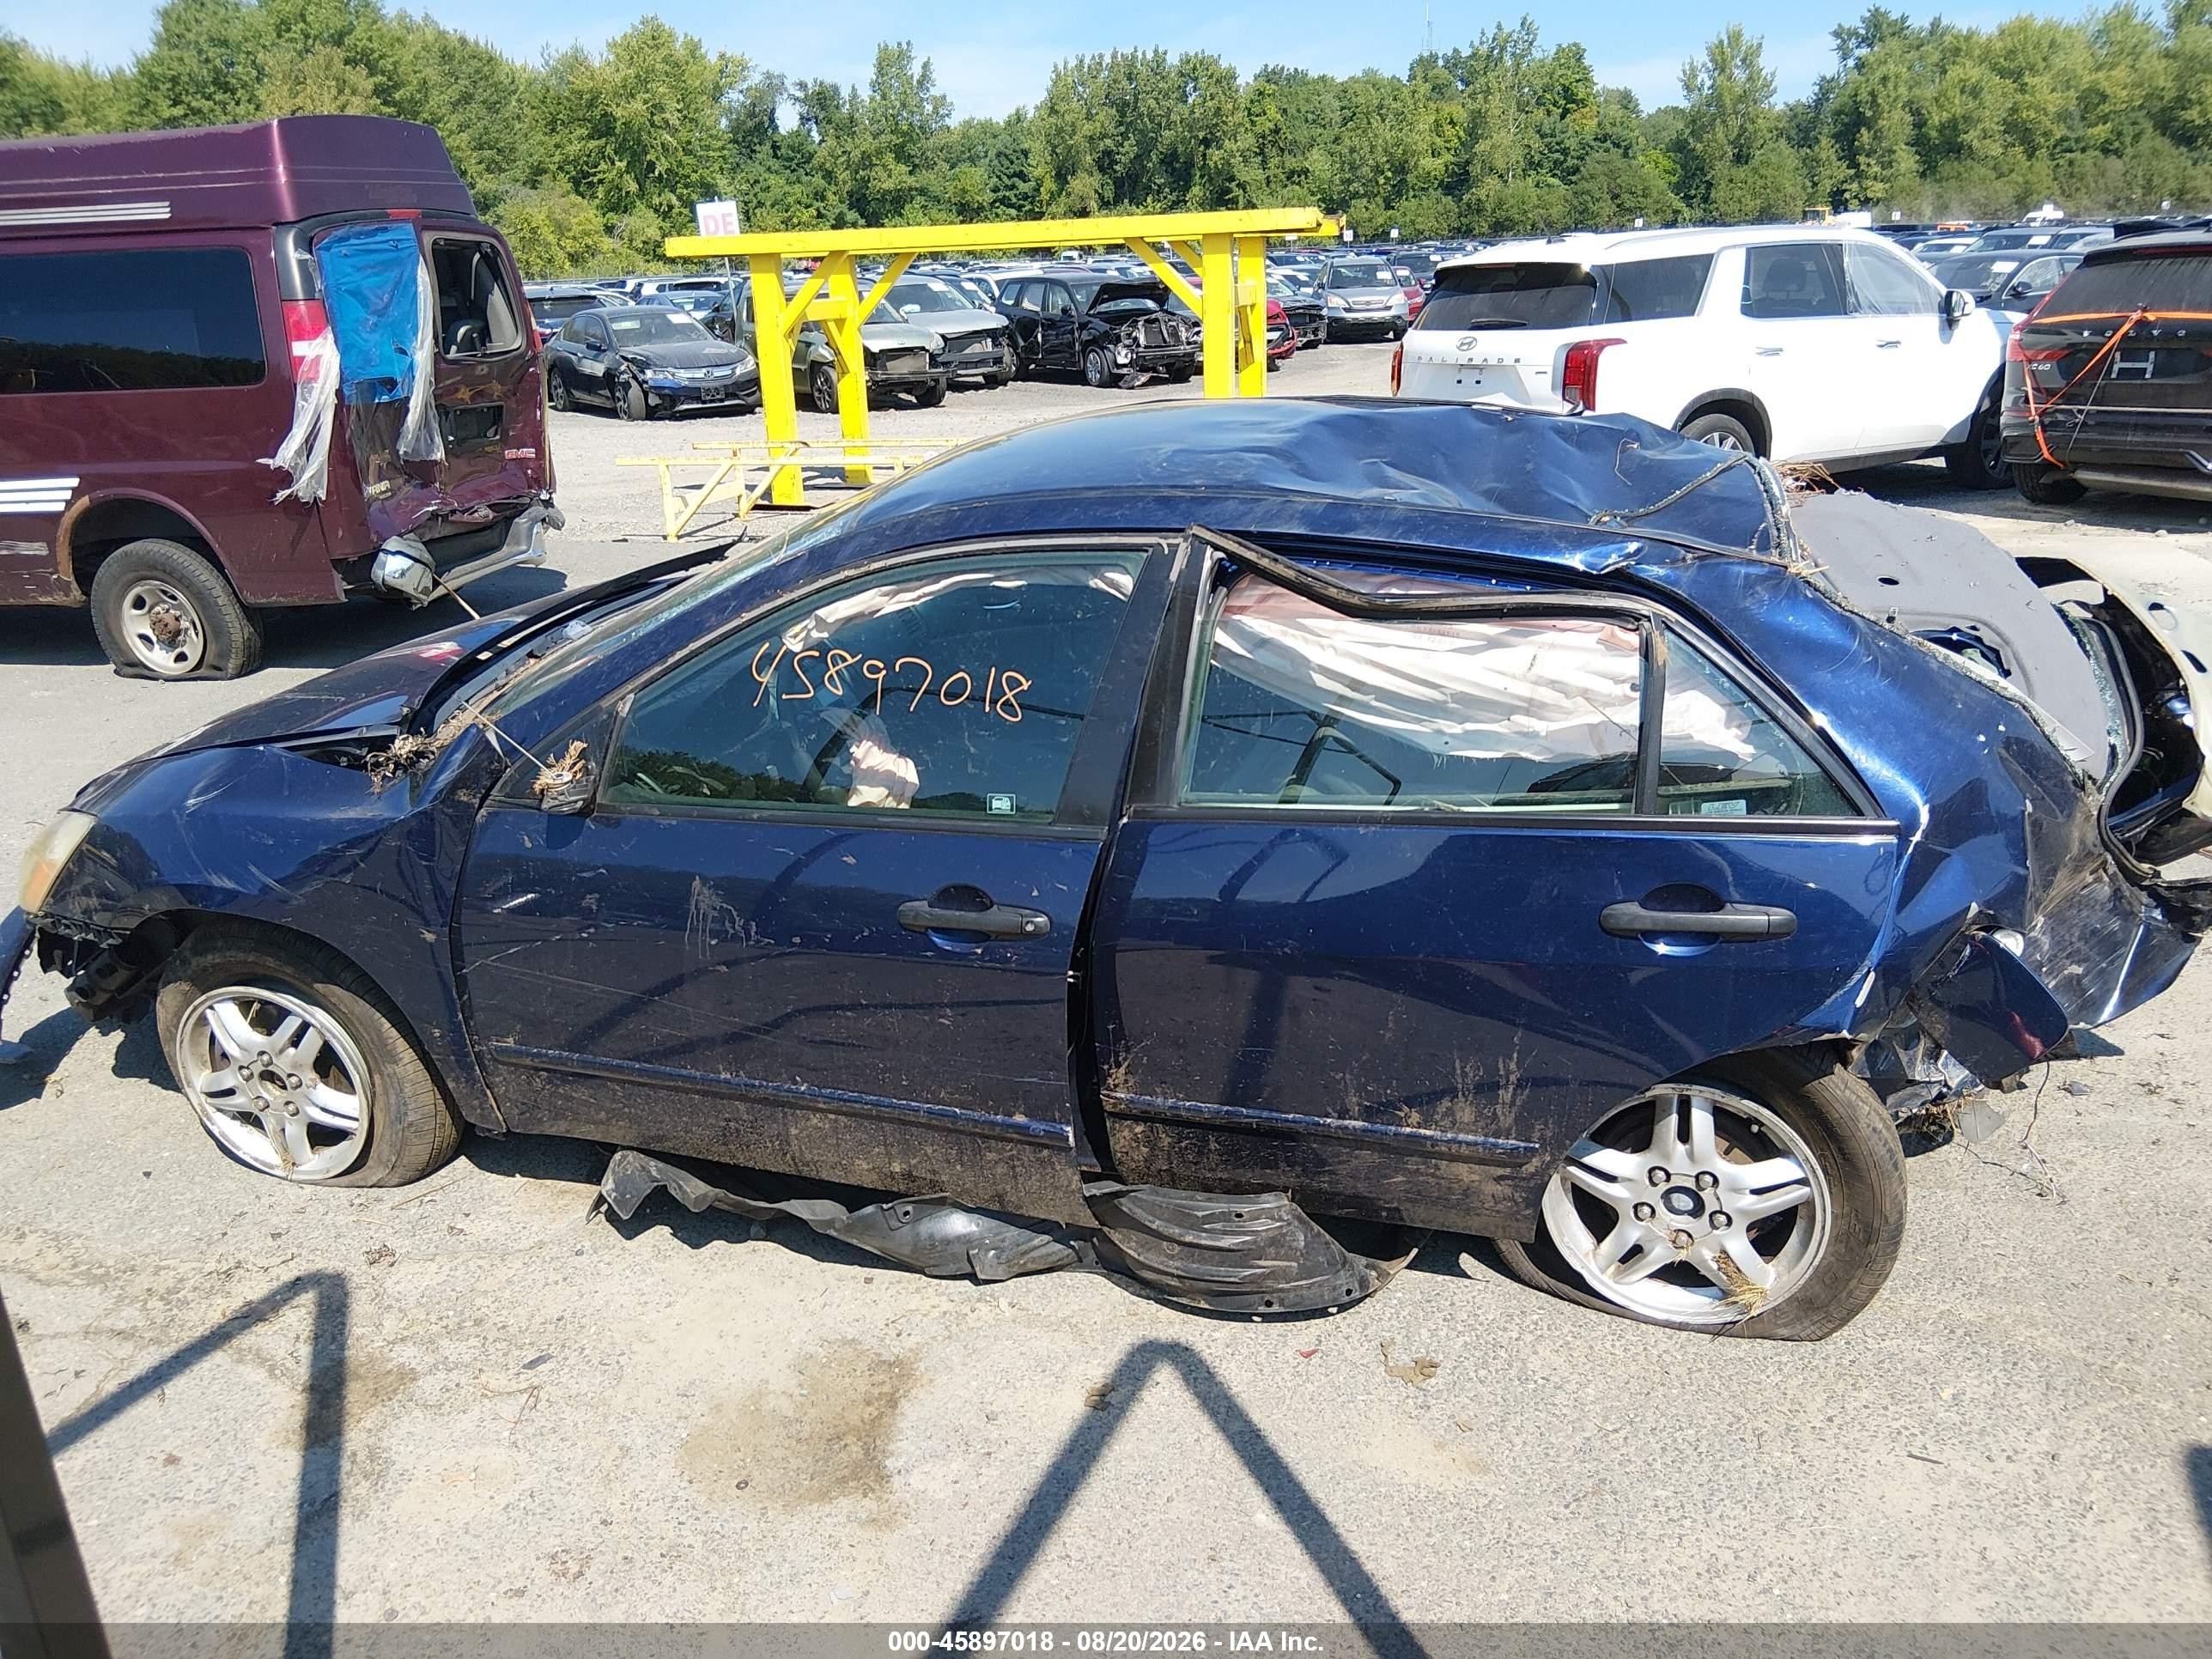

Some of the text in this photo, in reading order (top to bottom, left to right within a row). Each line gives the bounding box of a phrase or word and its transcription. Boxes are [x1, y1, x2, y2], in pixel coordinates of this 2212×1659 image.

[702, 212, 736, 235] DE
[2081, 329, 2187, 337] VOLVO
[1417, 356, 1521, 364] PALISADE
[504, 448, 537, 460] GMC
[750, 641, 1032, 722] 45897018
